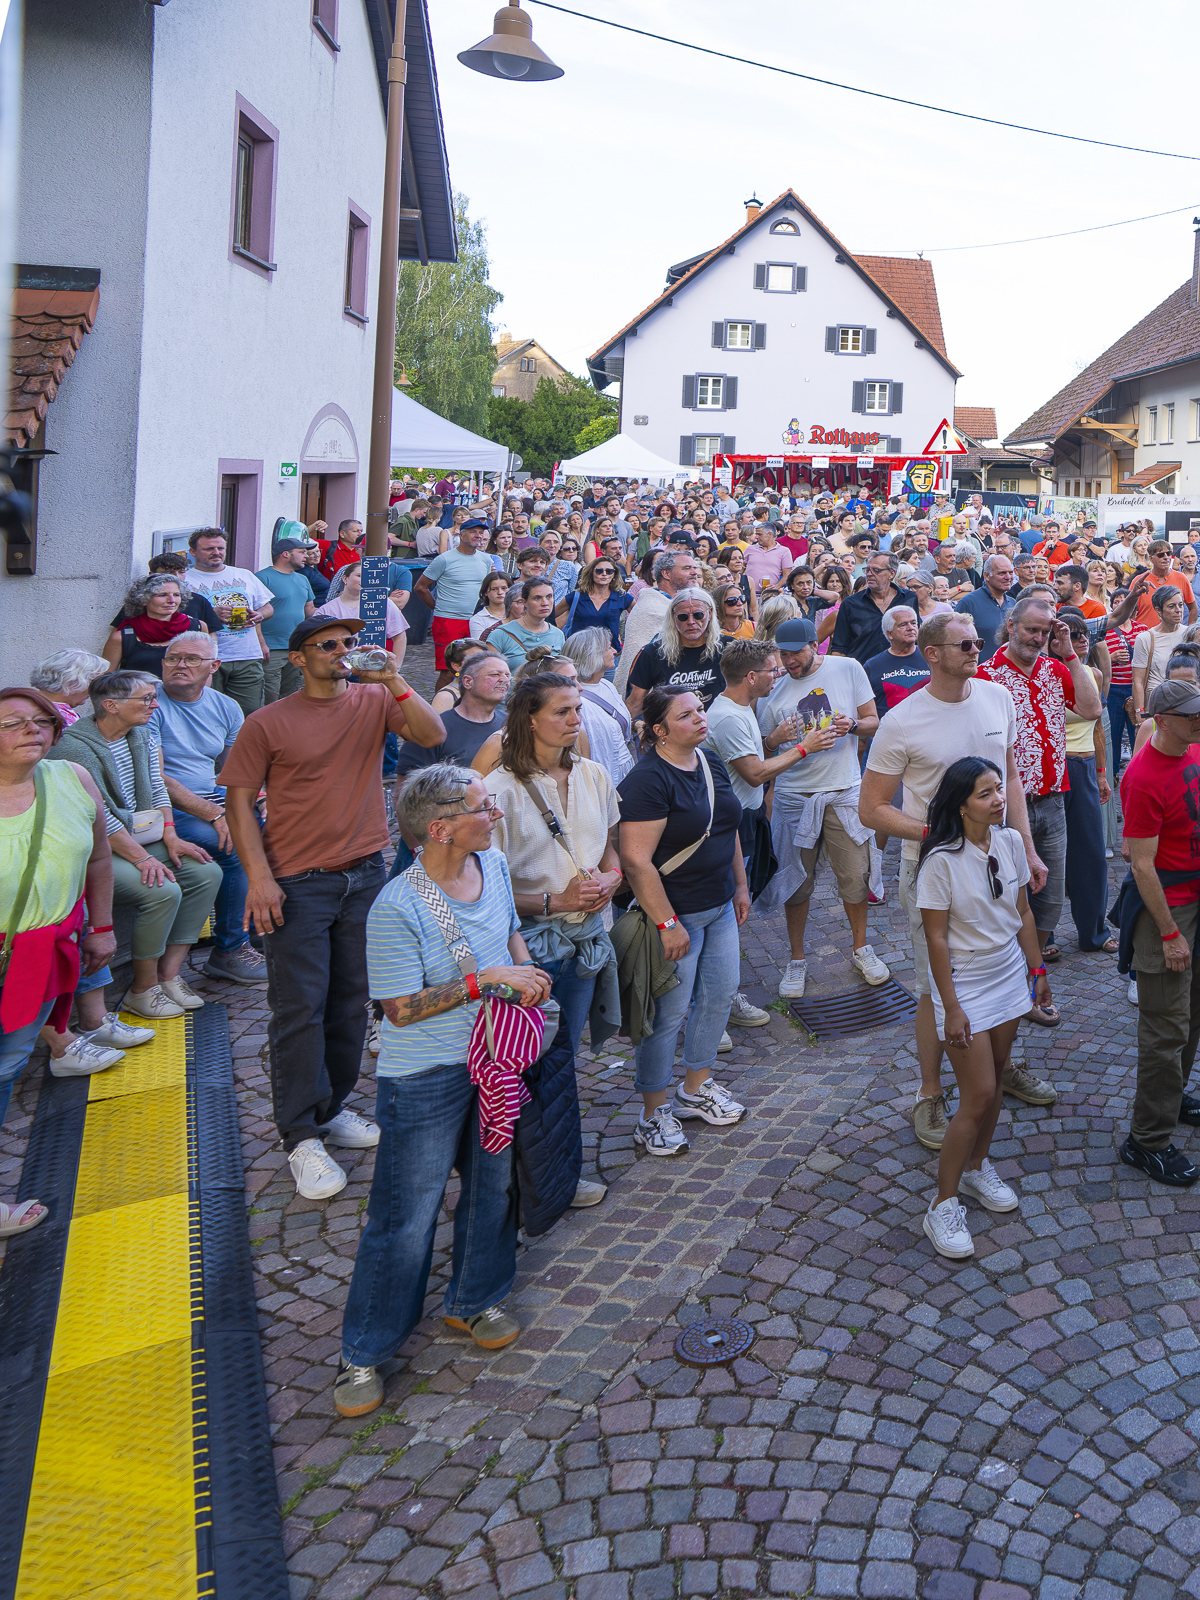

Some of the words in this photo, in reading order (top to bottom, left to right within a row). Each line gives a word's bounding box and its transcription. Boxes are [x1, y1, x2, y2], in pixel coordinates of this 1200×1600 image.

[808, 424, 880, 448] Rothaus
[1107, 496, 1145, 507] Breitenfeld
[1155, 498, 1171, 507] alten
[363, 561, 370, 569] S
